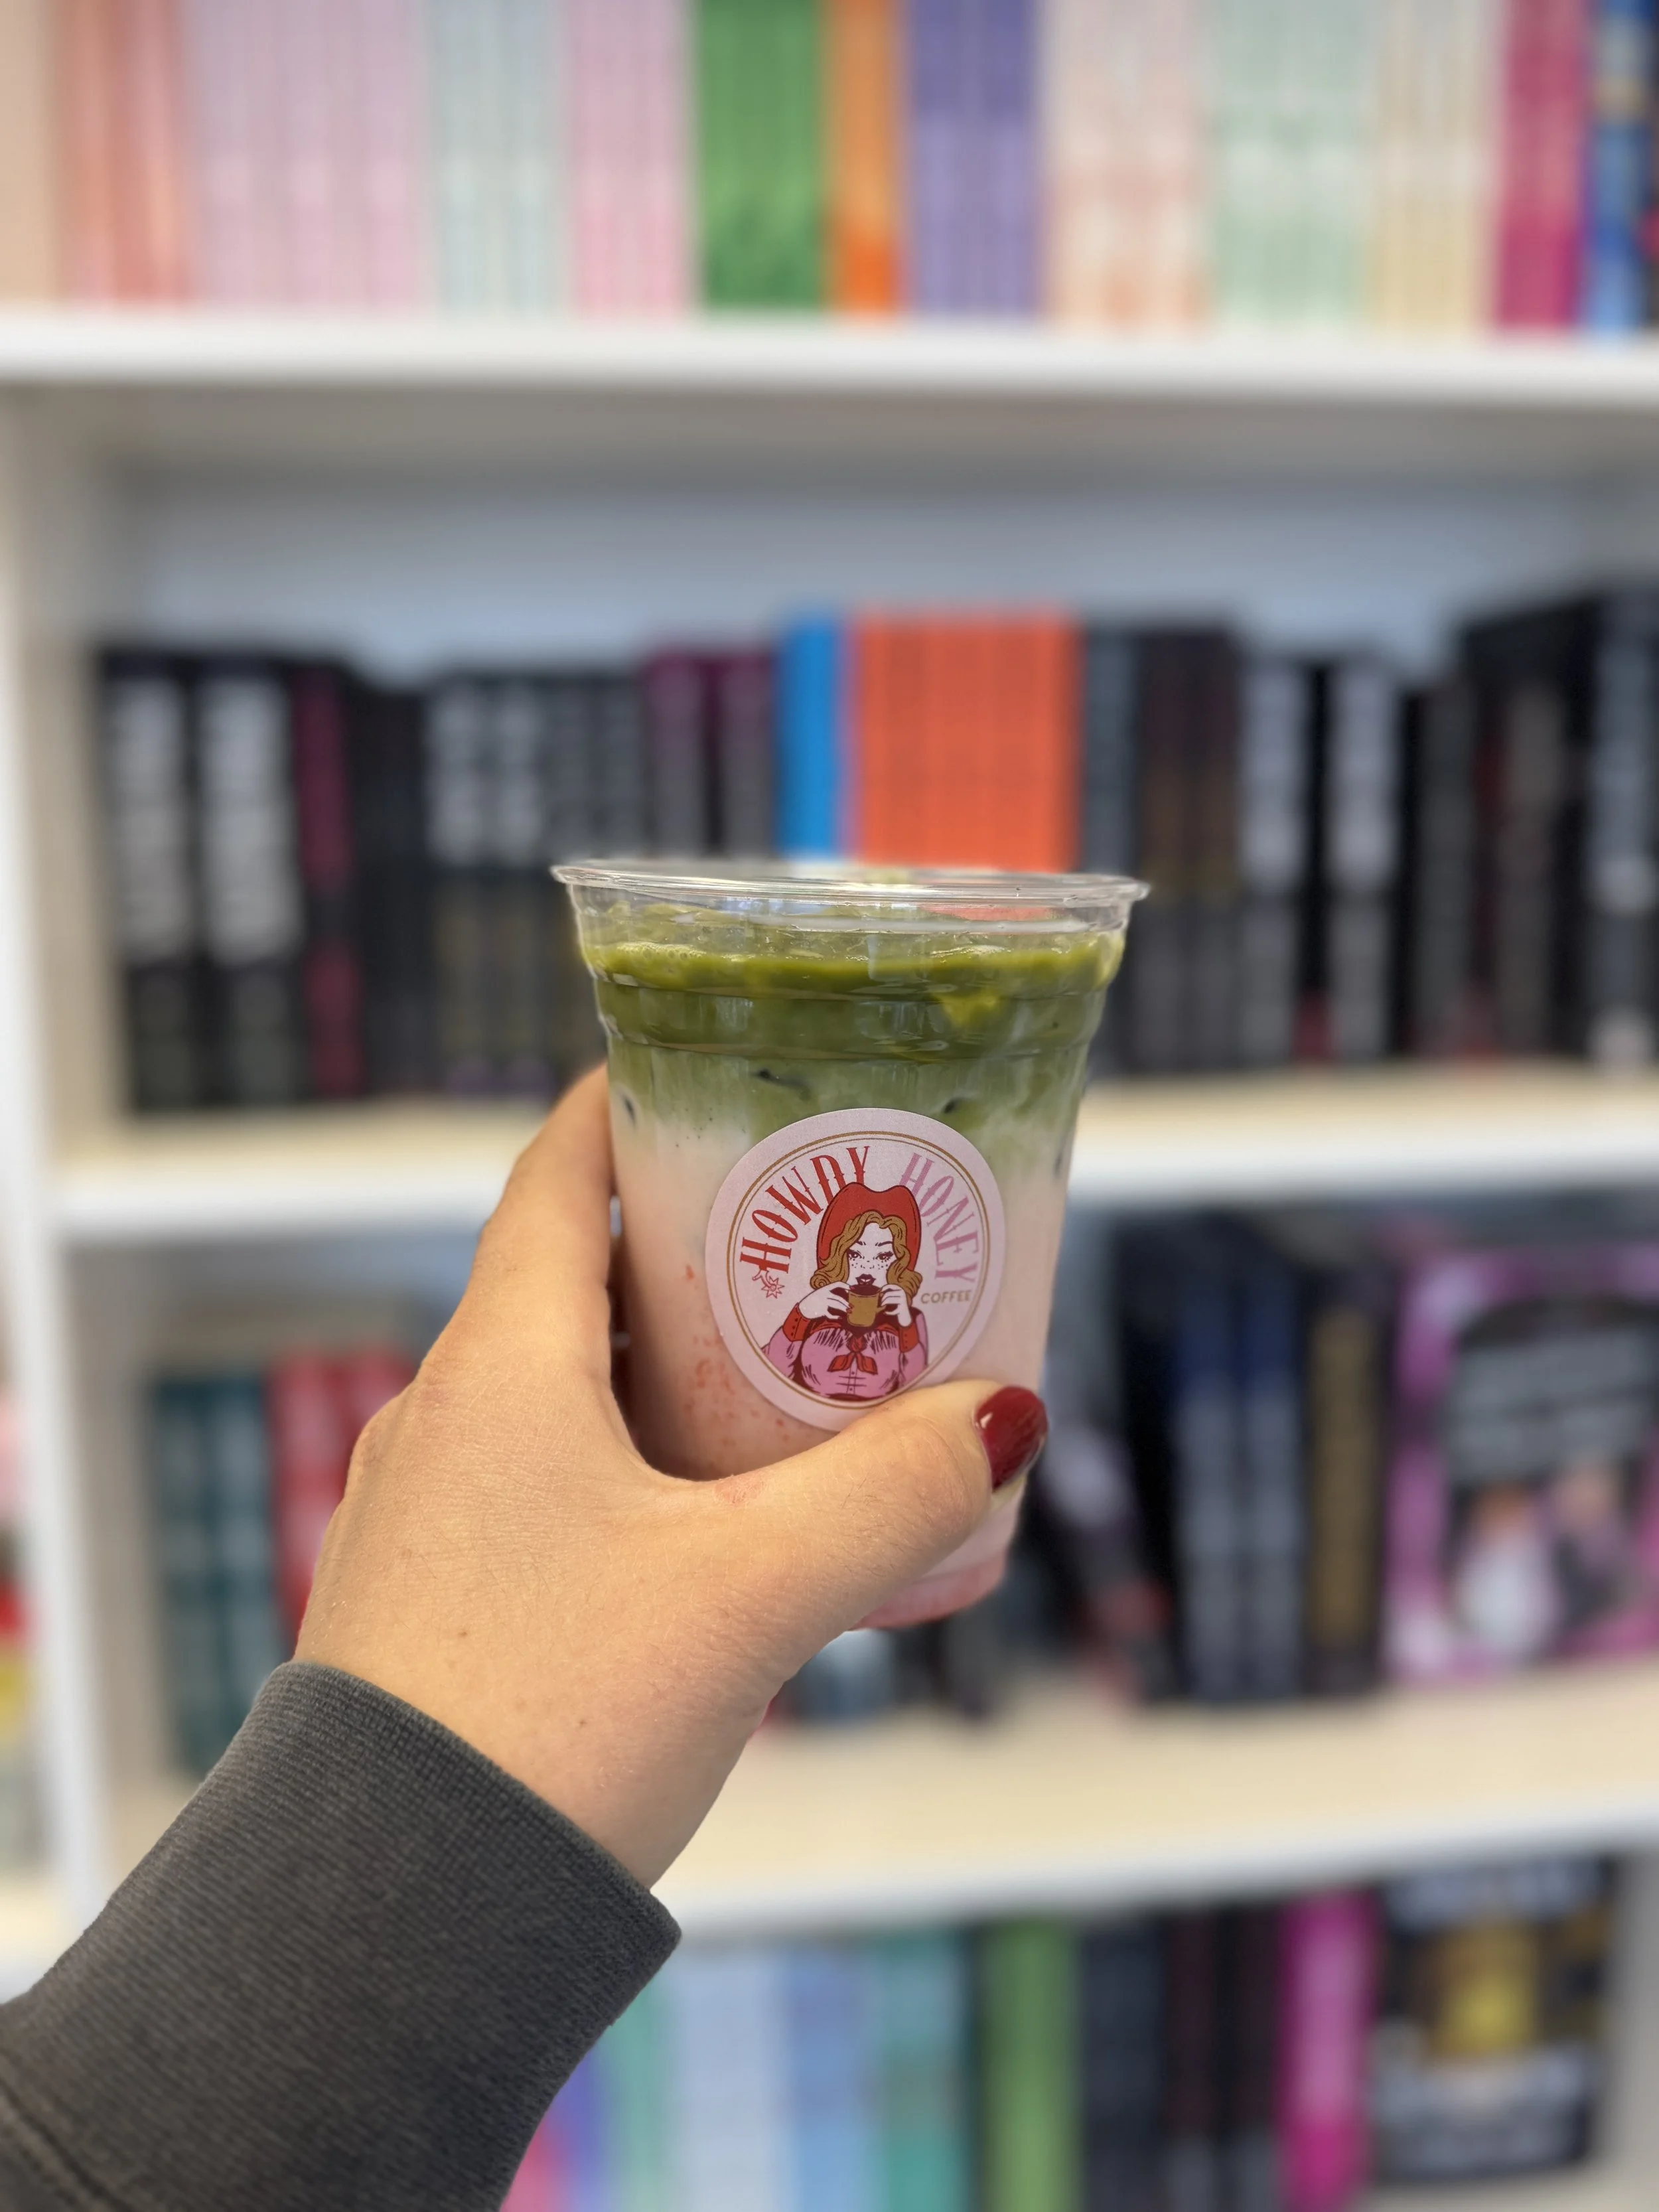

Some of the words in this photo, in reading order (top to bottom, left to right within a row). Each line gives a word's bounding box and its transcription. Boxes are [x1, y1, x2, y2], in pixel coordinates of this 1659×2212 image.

[739, 1145, 871, 1274] HOWDY
[899, 1153, 979, 1283] HONEY
[920, 1290, 972, 1305] COFFEE
